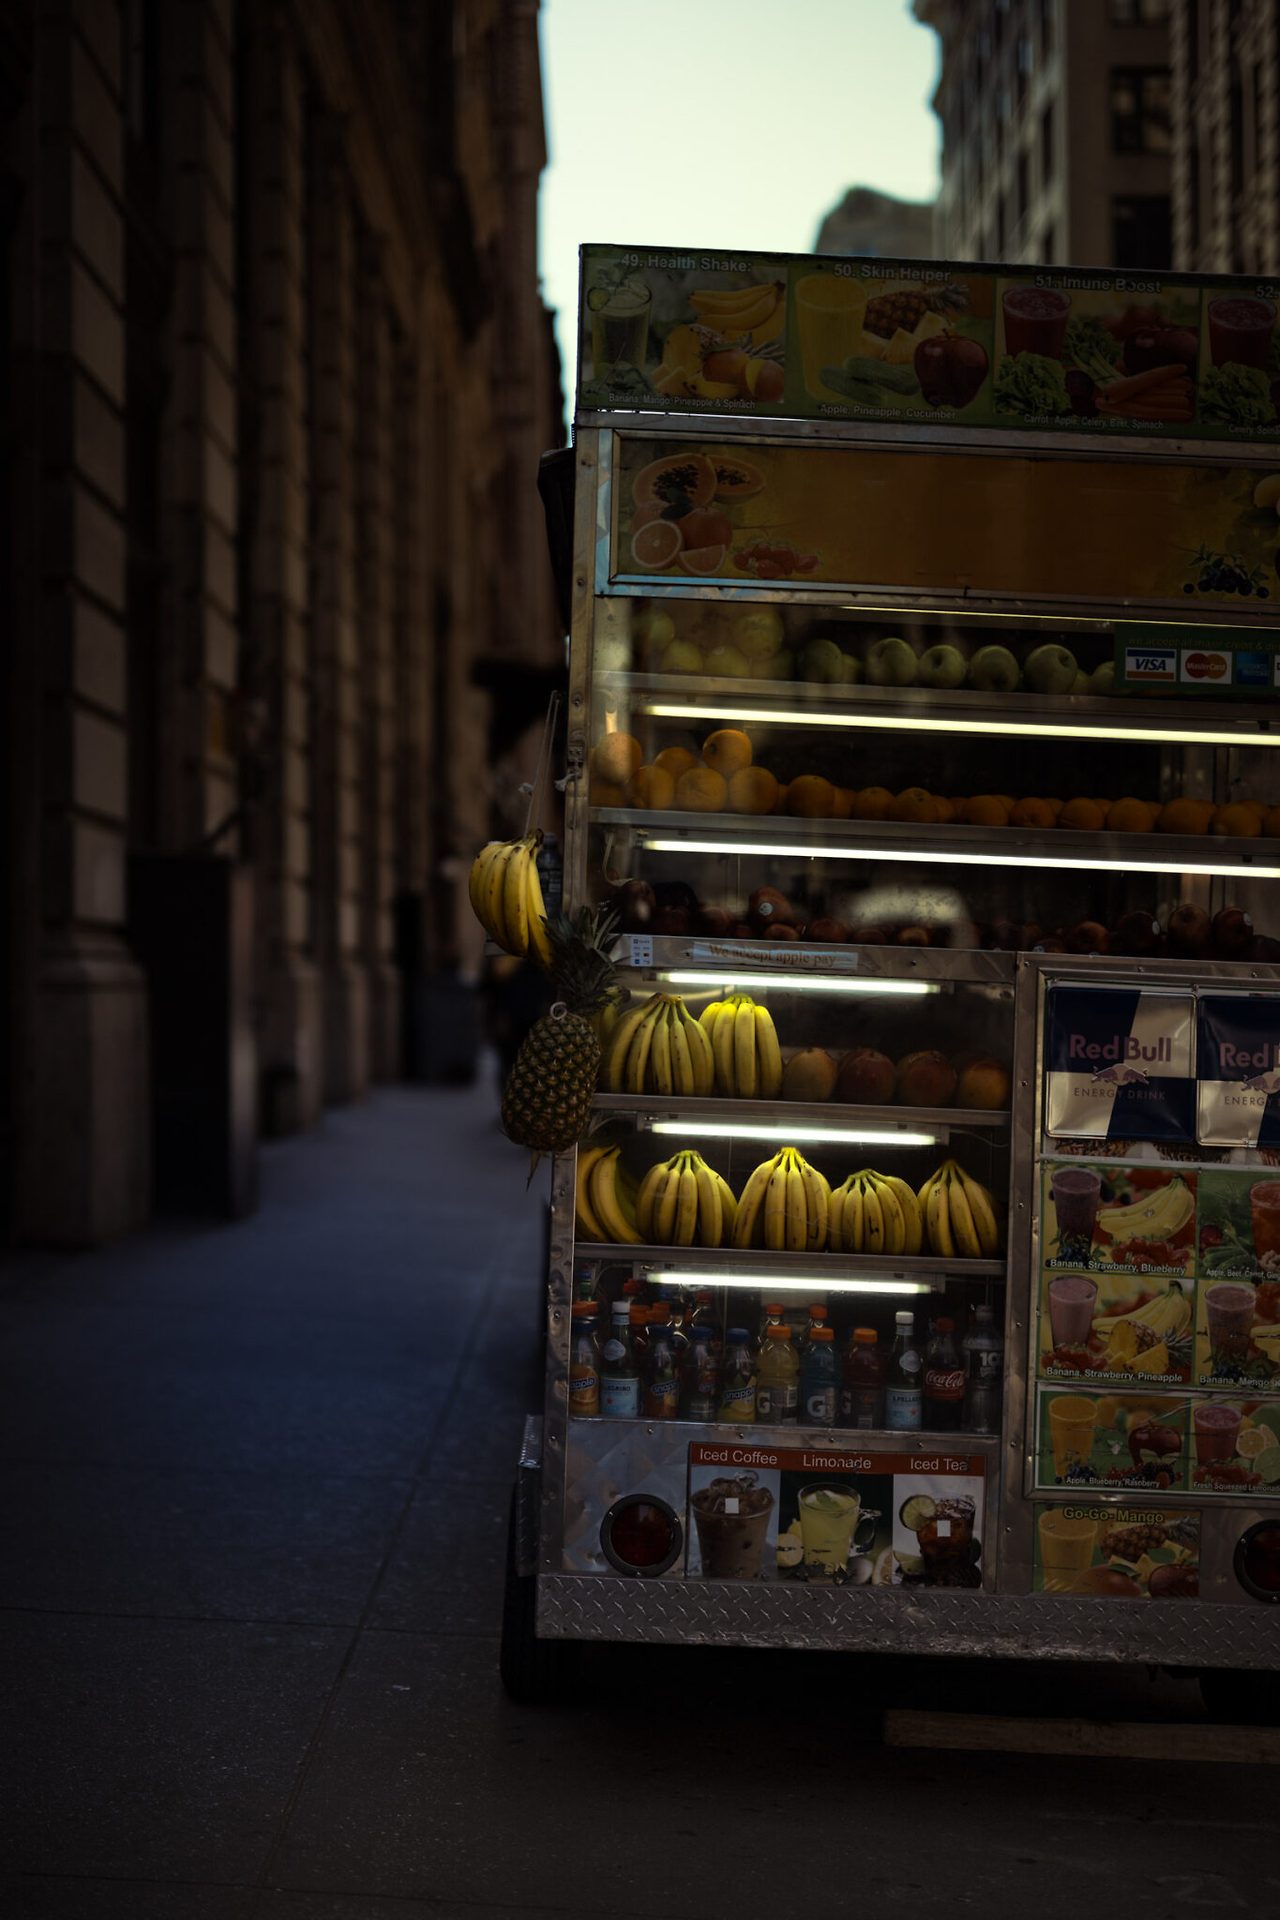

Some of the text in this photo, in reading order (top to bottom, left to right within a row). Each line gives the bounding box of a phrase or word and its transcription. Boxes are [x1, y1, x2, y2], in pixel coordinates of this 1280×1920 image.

[622, 253, 643, 267] 49.
[647, 255, 696, 269] Health
[833, 263, 856, 277] 50.
[861, 264, 896, 278] Skin
[1062, 277, 1110, 290] Imune
[1114, 278, 1162, 293] Boost
[1135, 658, 1167, 671] VISA
[1186, 662, 1226, 672] MasterCard
[709, 944, 834, 967] We accept apple pay
[1069, 1033, 1172, 1062] Red Bull
[1219, 1042, 1269, 1068] Red
[1074, 1087, 1167, 1101] ENERGY DRINK
[1050, 1259, 1087, 1270] Banana,
[1141, 1263, 1186, 1276] Blueberry
[1138, 1372, 1183, 1383] Pineapple
[806, 1395, 827, 1417] G
[699, 1447, 778, 1465] Iced Coffee
[802, 1454, 872, 1470] Limonade
[910, 1457, 969, 1472] Iced Tea
[1117, 1508, 1164, 1525] Mango
